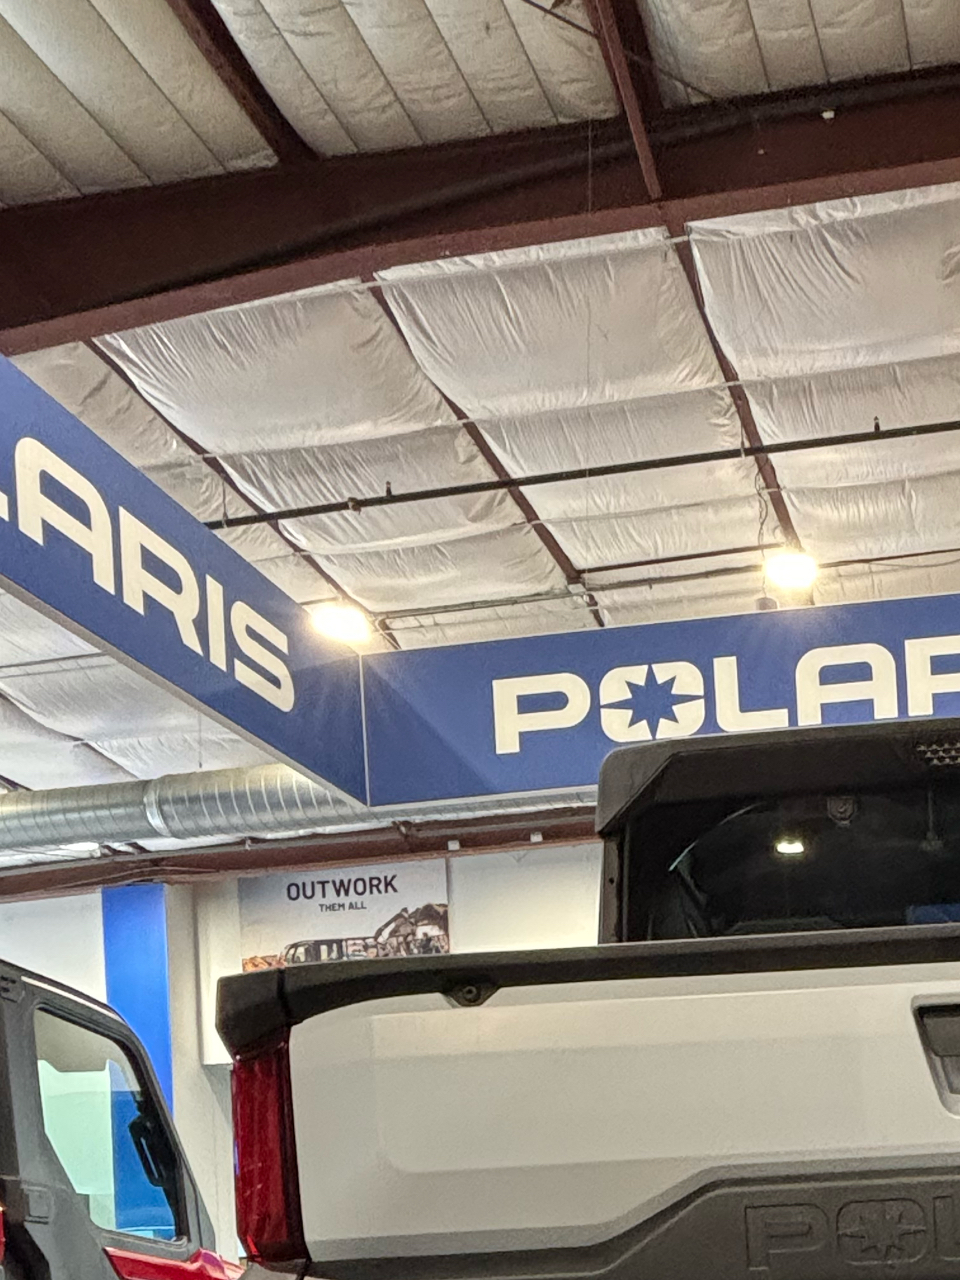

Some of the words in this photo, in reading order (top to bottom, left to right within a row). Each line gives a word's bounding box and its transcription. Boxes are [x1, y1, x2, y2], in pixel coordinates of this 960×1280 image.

[0, 436, 295, 713] ARIS
[287, 875, 398, 901] OUTWORK
[319, 902, 345, 913] THEM
[348, 901, 367, 911] ALL
